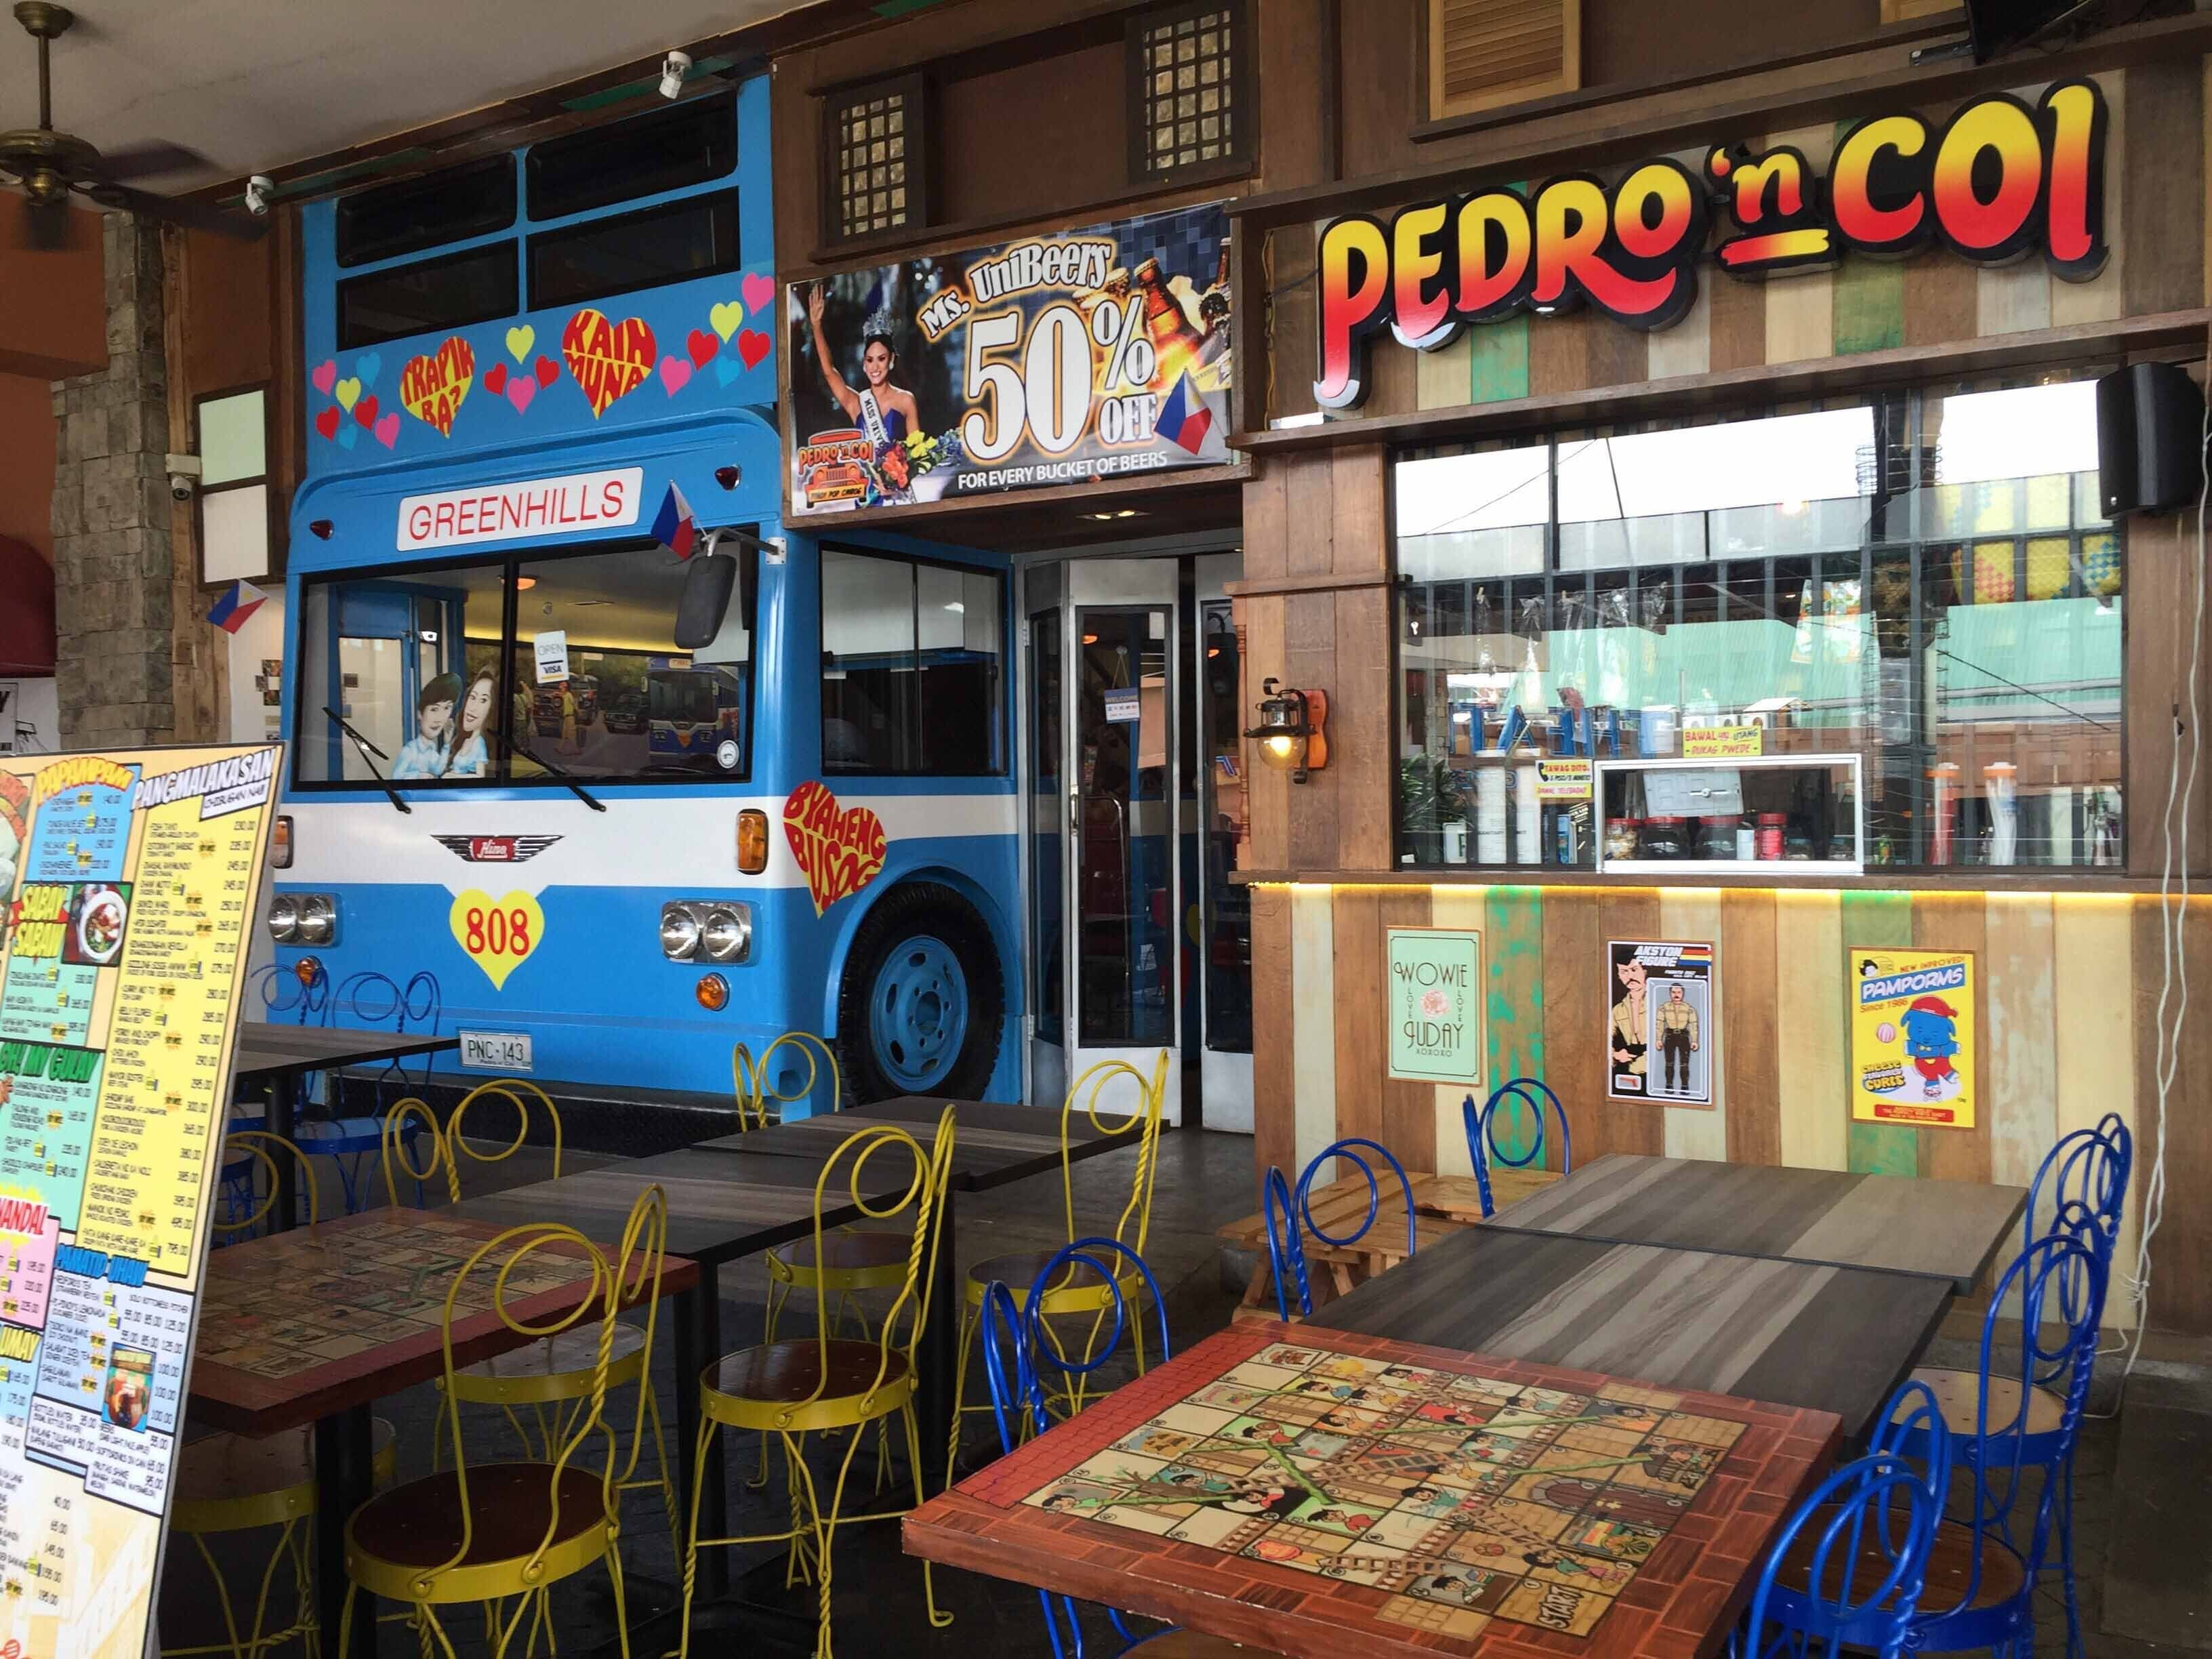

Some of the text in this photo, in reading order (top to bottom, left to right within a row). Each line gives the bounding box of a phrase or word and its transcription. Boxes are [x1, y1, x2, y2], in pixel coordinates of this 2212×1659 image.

[920, 242, 1111, 336] Ms. UniBeers
[1321, 165, 1692, 399] PEDRO
[563, 309, 656, 369] KAIN
[401, 336, 474, 407] TRAPIK
[565, 352, 651, 416] MUNA
[963, 294, 1155, 460] 50%
[422, 384, 462, 438] BA?
[1099, 392, 1158, 445] OFF
[798, 445, 838, 474] PEDRO
[958, 450, 1168, 490] FOR EVERY BUCKET OF BEERS
[409, 480, 623, 542] GREENHILLS
[1685, 731, 1717, 741] BAWAL
[130, 748, 275, 813] PANGMALAKASAN
[1544, 764, 1570, 772] TAWAG
[466, 908, 530, 956] 808
[1393, 962, 1467, 987] WOWIE
[1862, 967, 1964, 1000] PAMPORMS
[1406, 987, 1414, 1019] LOVE
[1456, 989, 1465, 1022] LOVE
[1536, 1584, 1585, 1629] START
